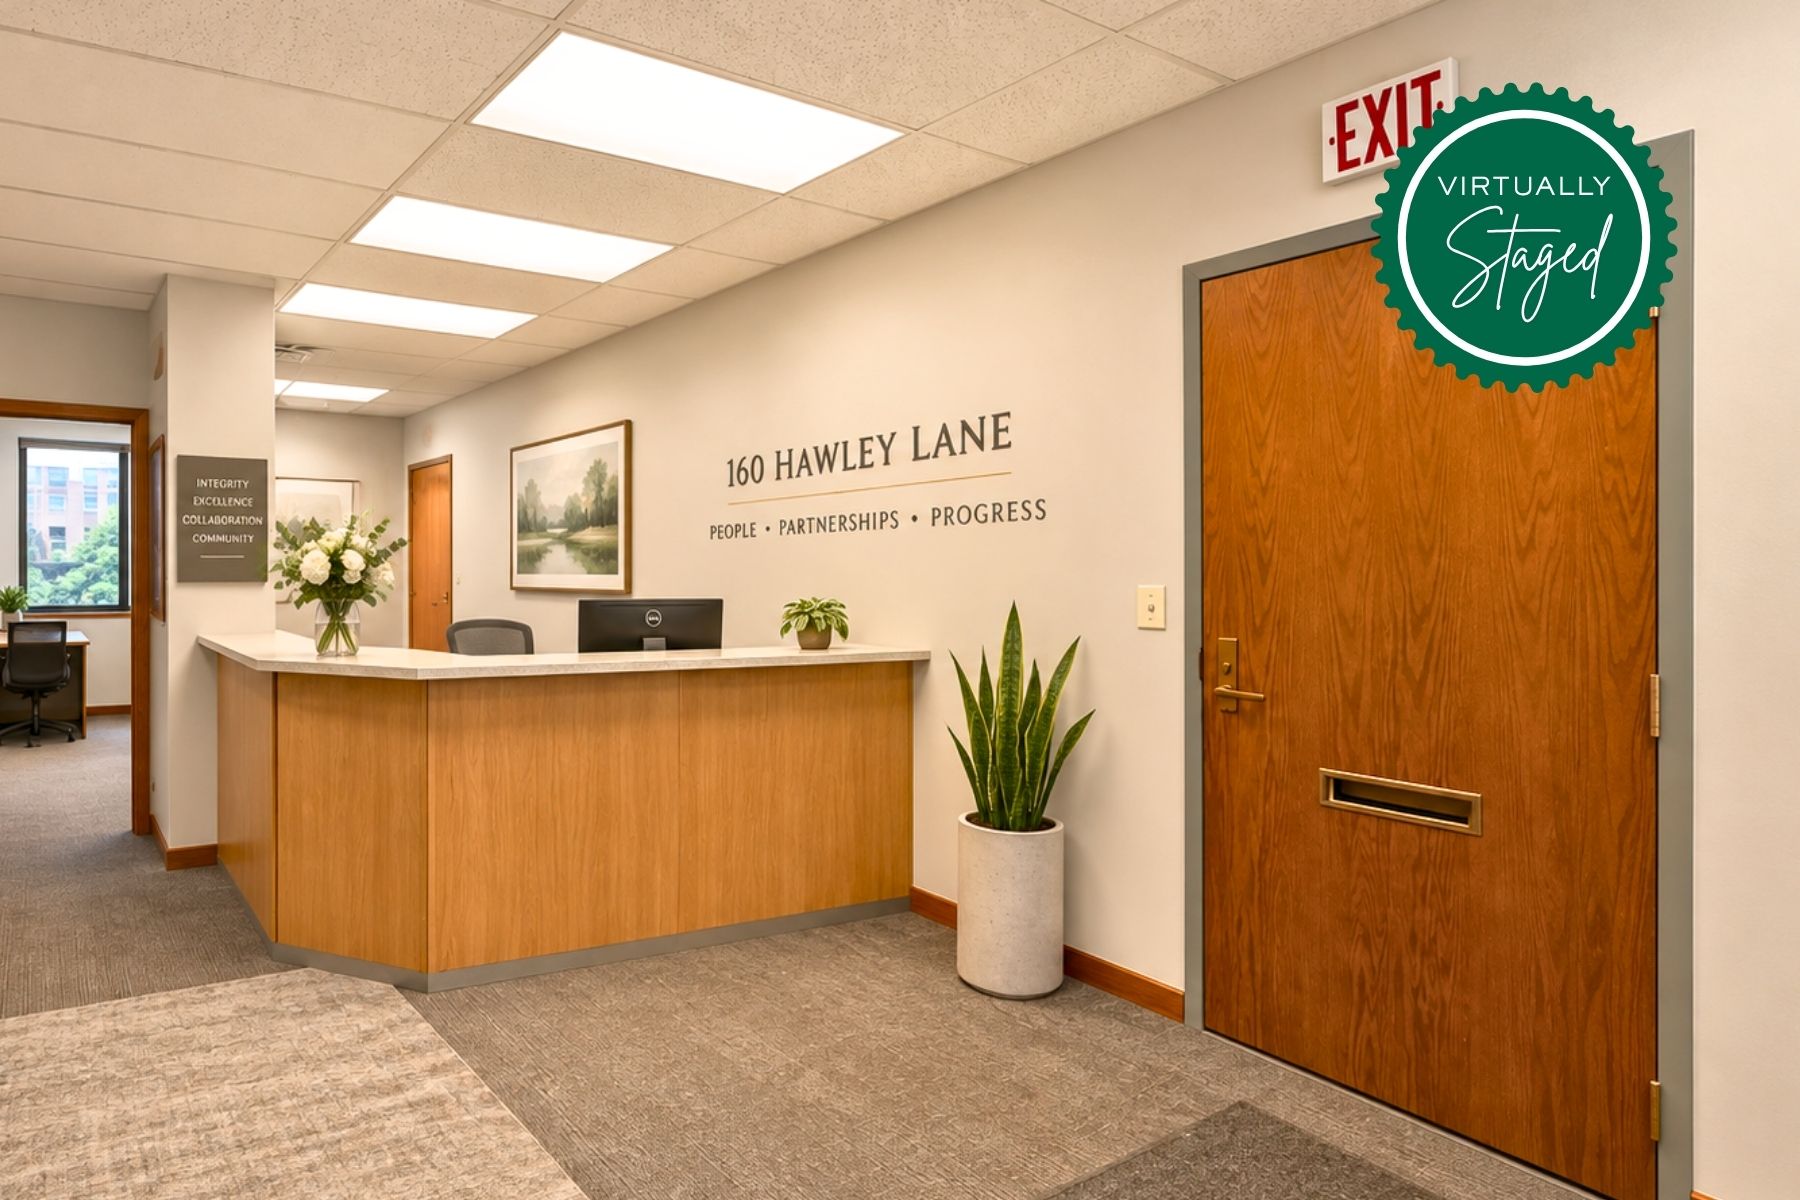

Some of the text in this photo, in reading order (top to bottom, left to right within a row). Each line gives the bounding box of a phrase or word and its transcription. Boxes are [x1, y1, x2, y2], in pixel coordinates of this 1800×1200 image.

[1335, 69, 1441, 173] EXIT
[726, 411, 1012, 488] 160 HAWLEY LANE
[196, 478, 249, 489] INTEGRITY
[192, 496, 253, 507] EXCELLENCE
[182, 514, 263, 526] COLLABORATION
[709, 498, 1047, 541] PEOPLE PARTNERSHIPS PROGRESS
[192, 533, 254, 544] COMMUNITY
